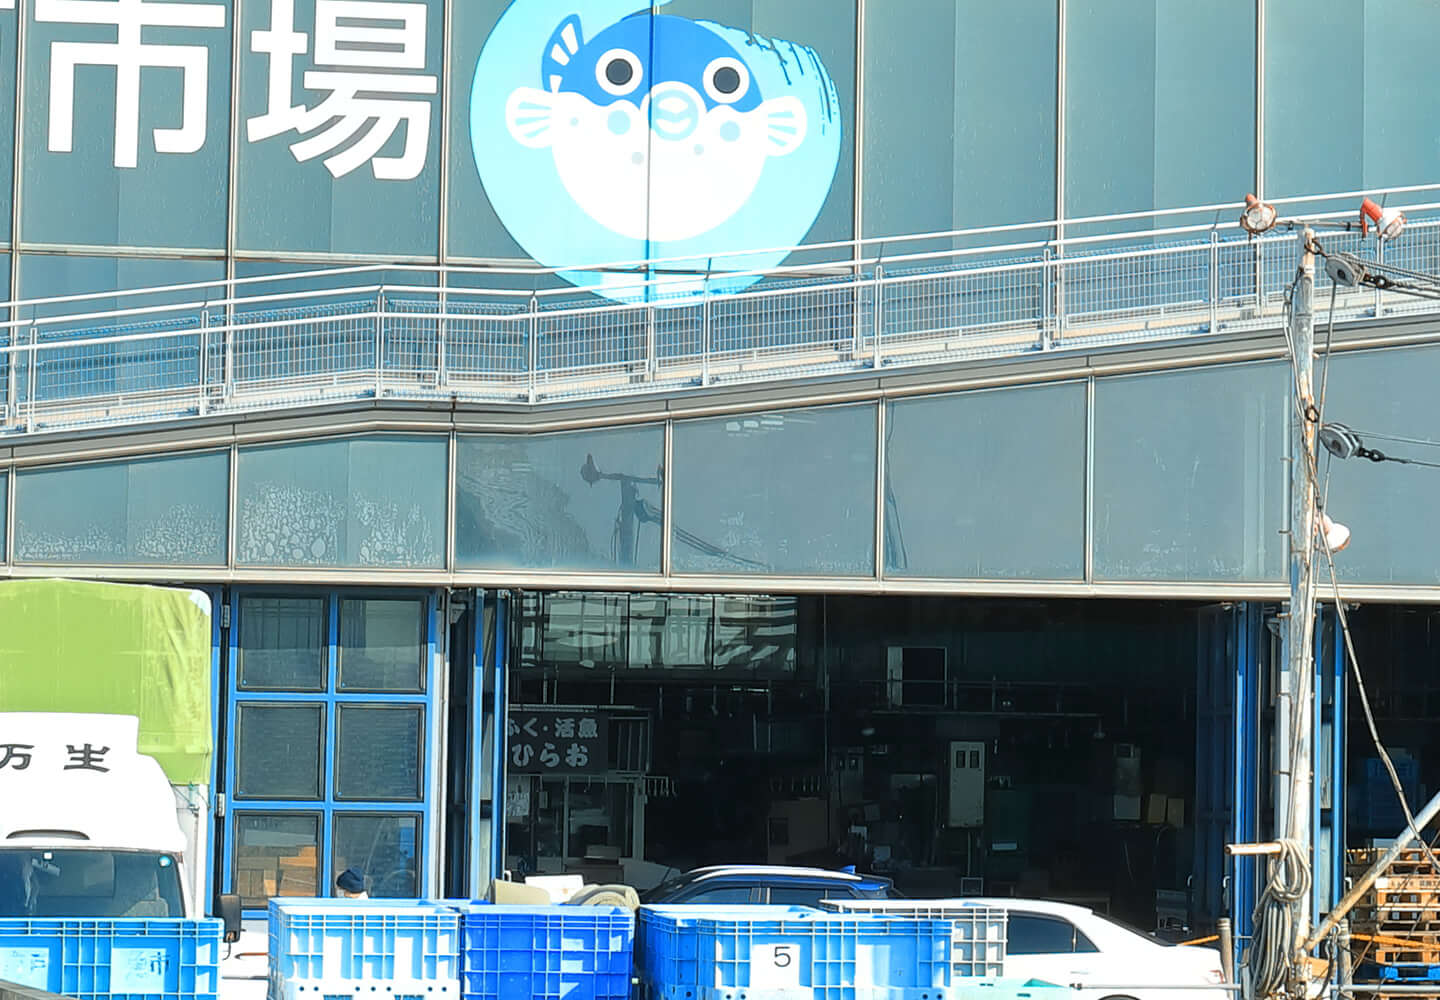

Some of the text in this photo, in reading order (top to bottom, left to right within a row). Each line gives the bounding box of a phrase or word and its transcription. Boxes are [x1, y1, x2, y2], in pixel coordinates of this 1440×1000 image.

[511, 742, 588, 768] ひらお
[774, 946, 791, 967] 5
